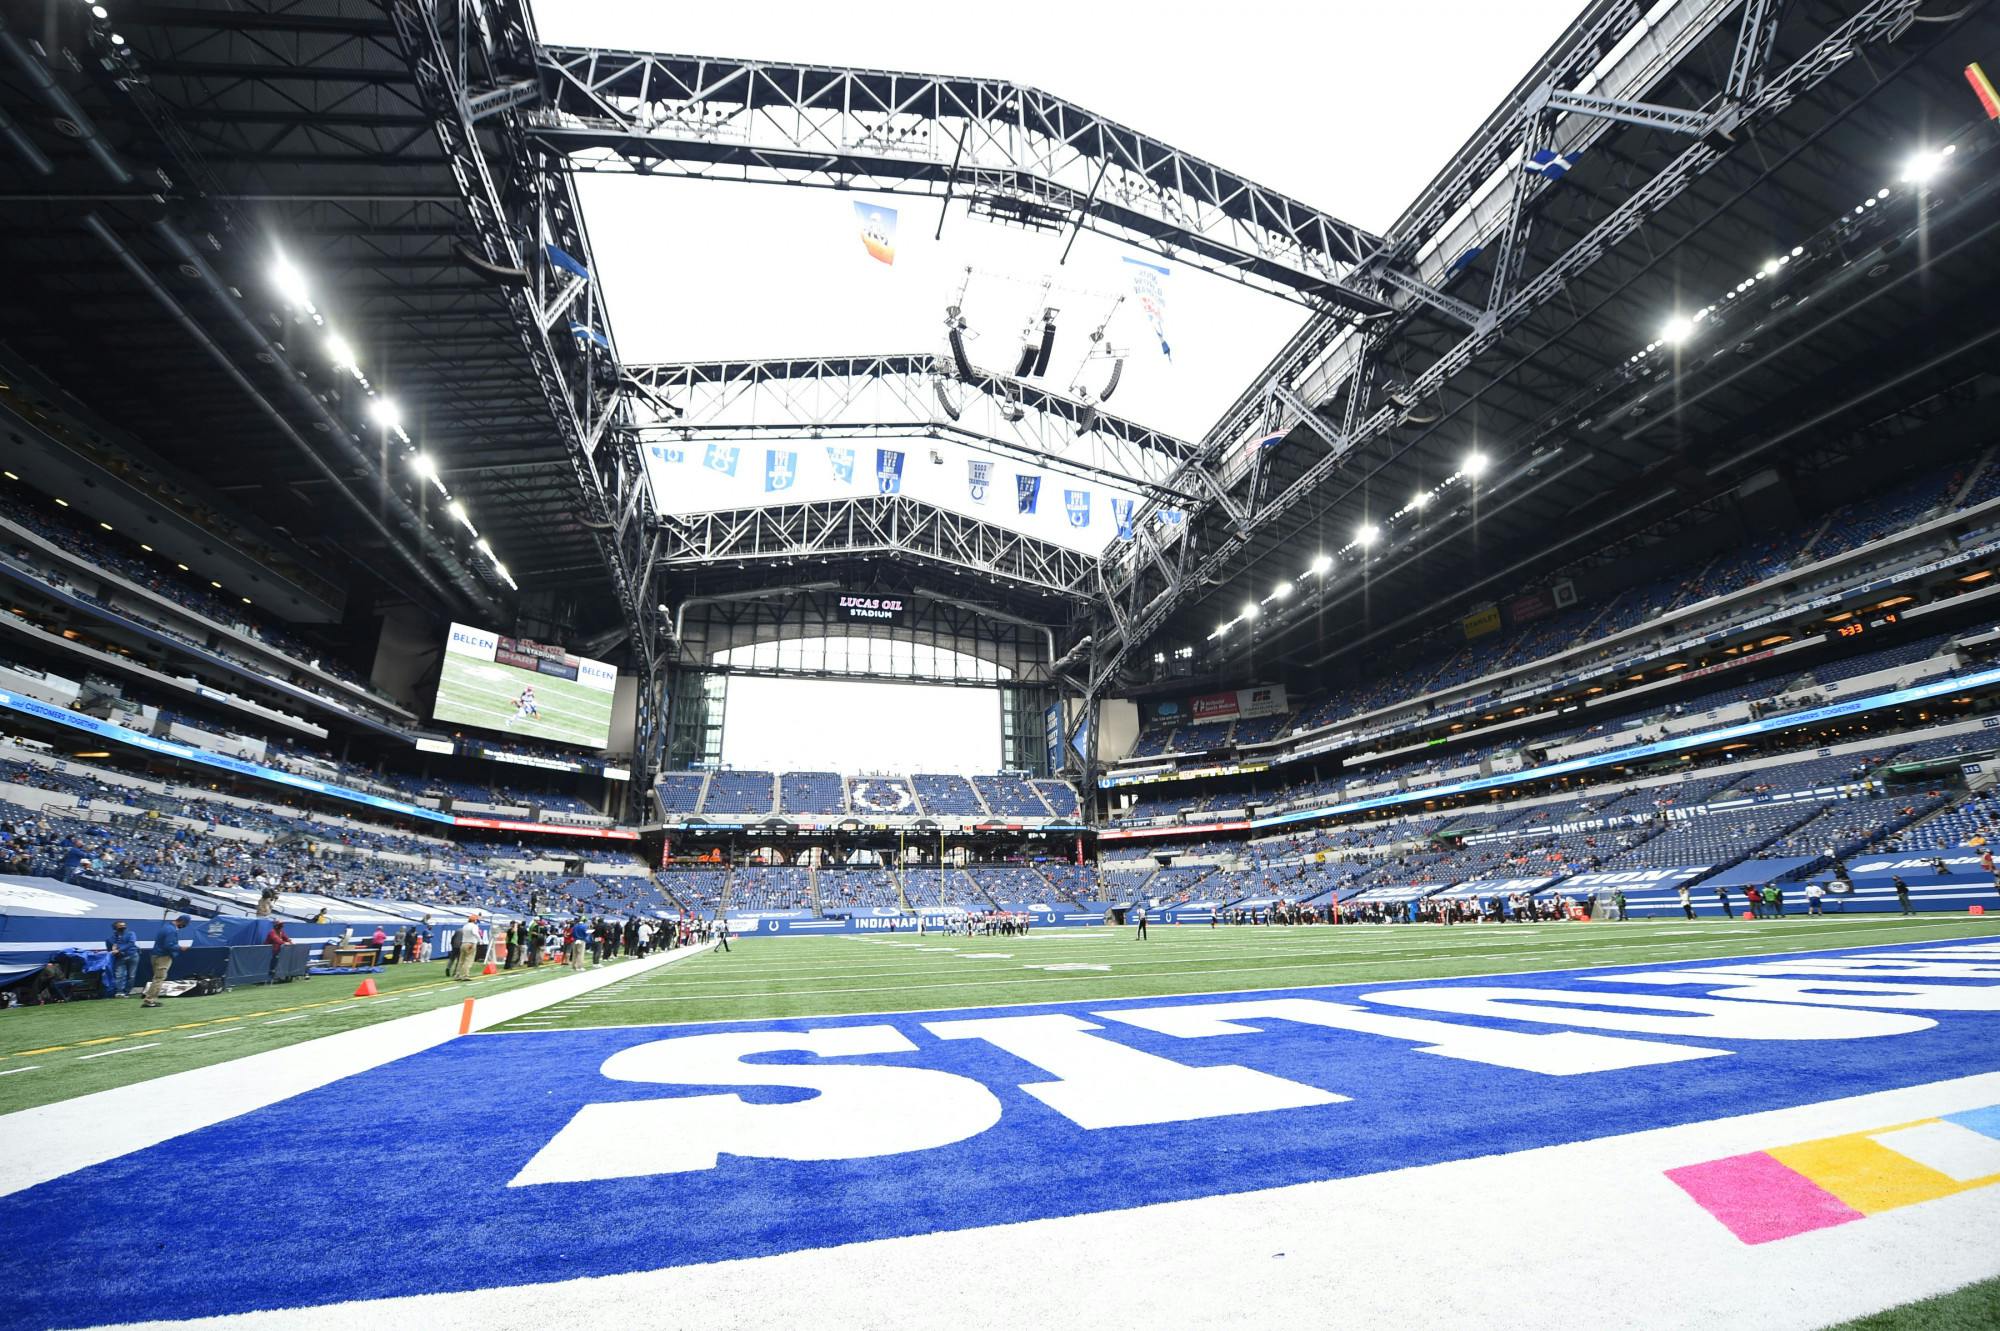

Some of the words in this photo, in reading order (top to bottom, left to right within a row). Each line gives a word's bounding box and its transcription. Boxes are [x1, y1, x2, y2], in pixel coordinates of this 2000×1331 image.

[839, 596, 879, 609] LUCAS
[881, 600, 903, 611] OIL
[850, 608, 892, 618] STADIUM
[25, 702, 66, 721] CUSTOMERS
[67, 715, 99, 730] TOGETHER
[1775, 711, 1821, 727] CUSTOMERS
[1821, 703, 1861, 719] TOGETHER
